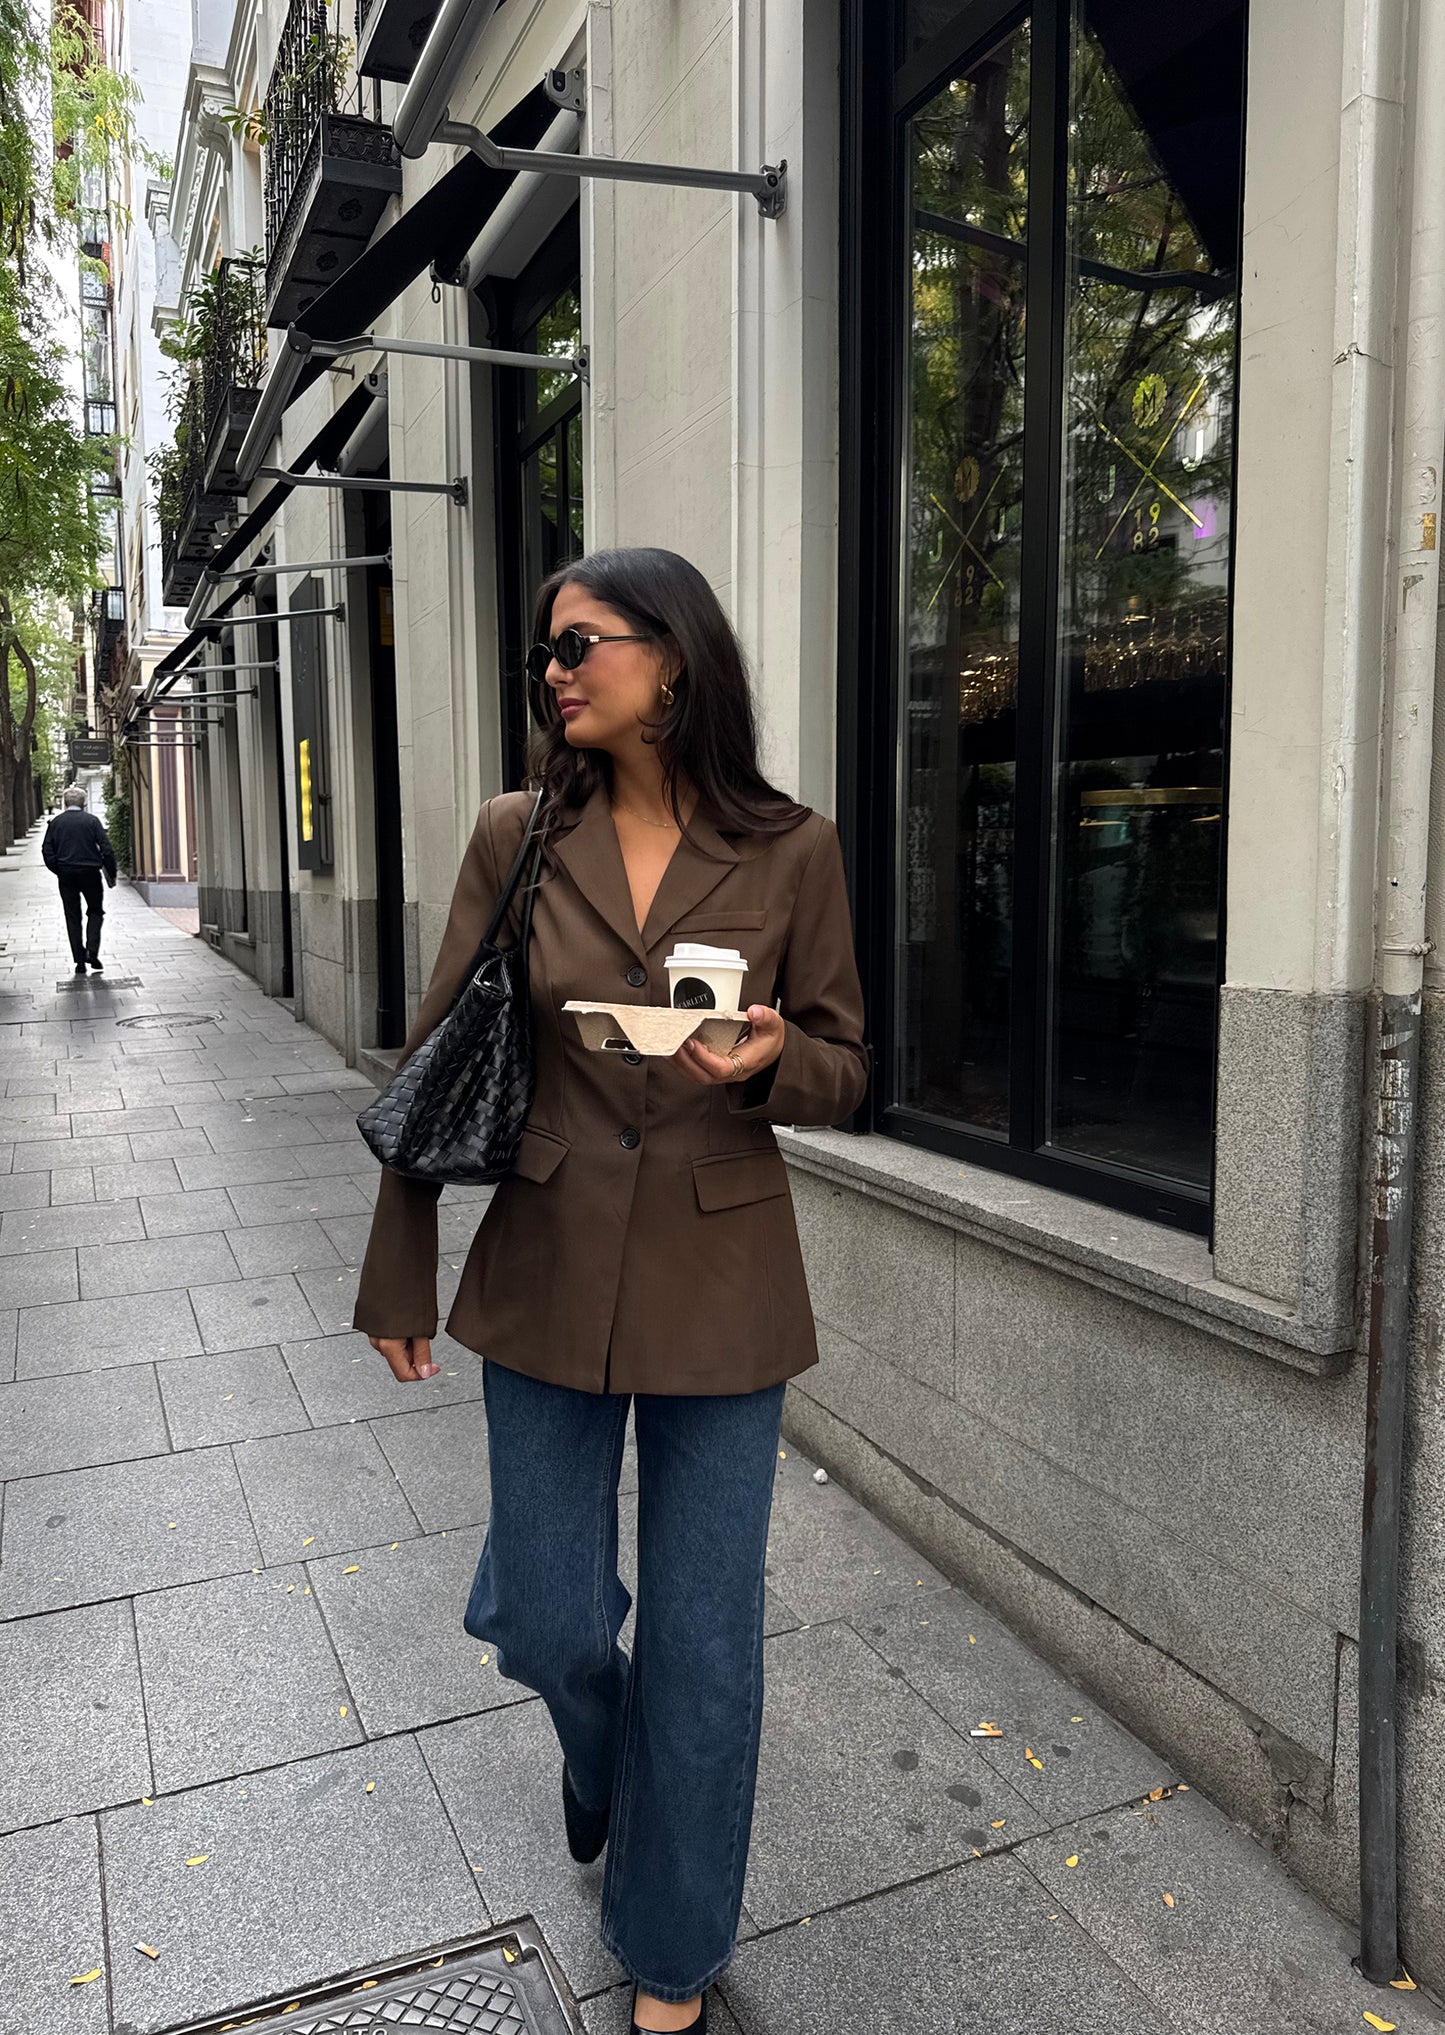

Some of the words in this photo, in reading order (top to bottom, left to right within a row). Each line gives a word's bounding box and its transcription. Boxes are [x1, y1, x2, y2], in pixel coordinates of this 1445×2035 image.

[1182, 429, 1205, 473] J
[1098, 464, 1117, 503] J
[990, 507, 1006, 542] J
[929, 530, 944, 562] J
